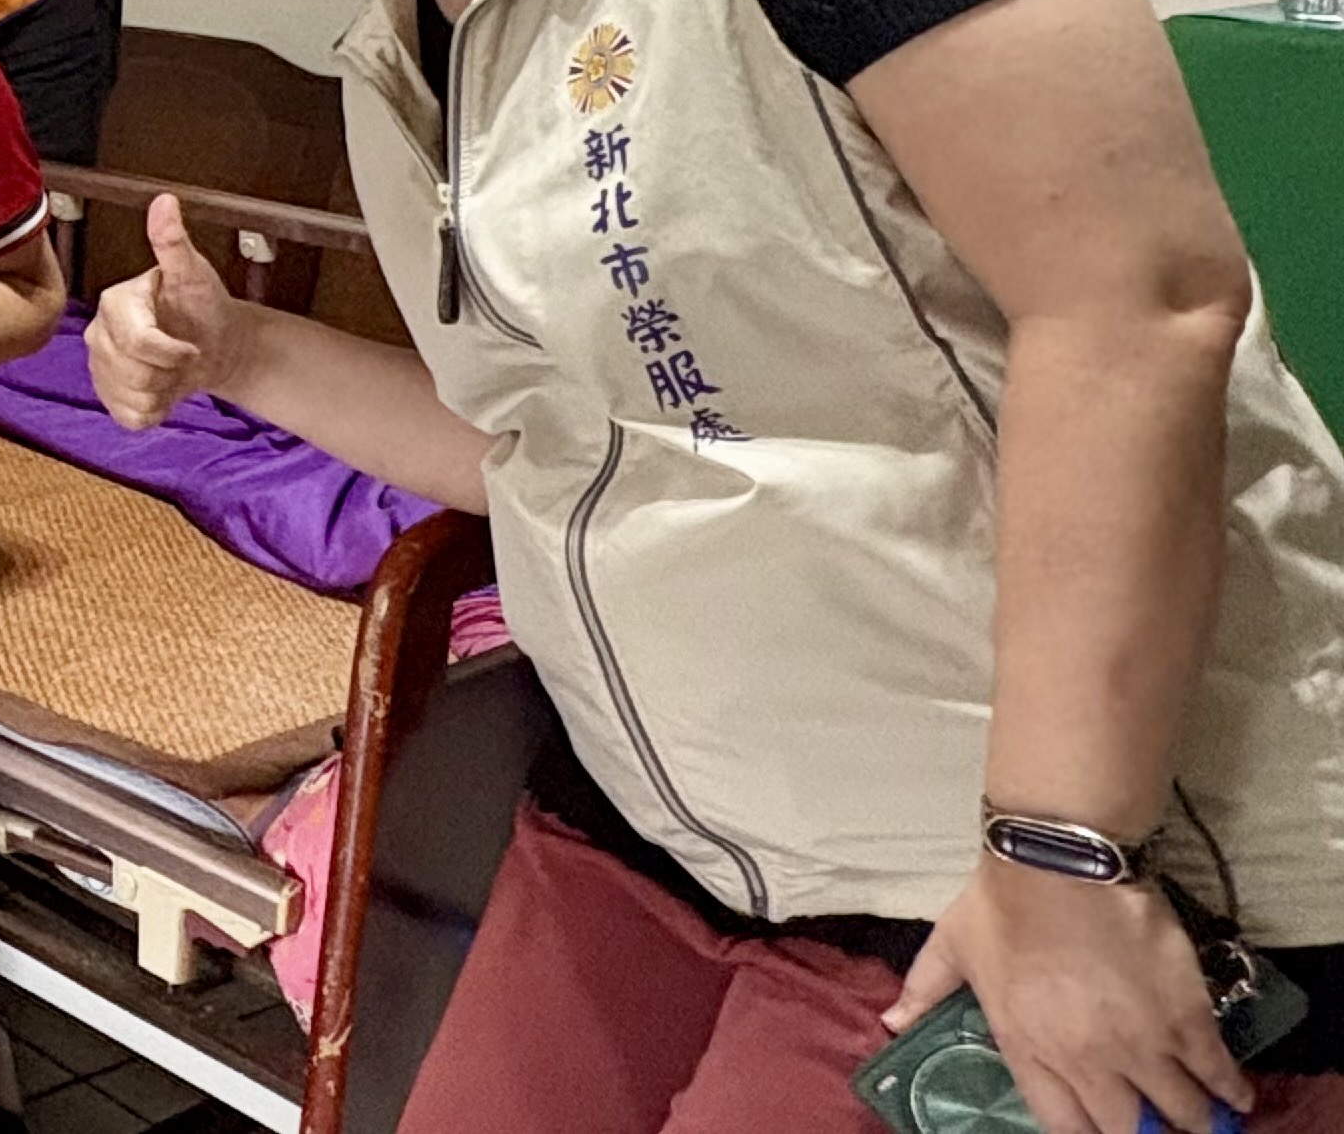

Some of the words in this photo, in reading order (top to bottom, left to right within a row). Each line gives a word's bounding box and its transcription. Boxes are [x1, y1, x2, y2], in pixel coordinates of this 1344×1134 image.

[584, 123, 753, 454] 新北市榮服處
